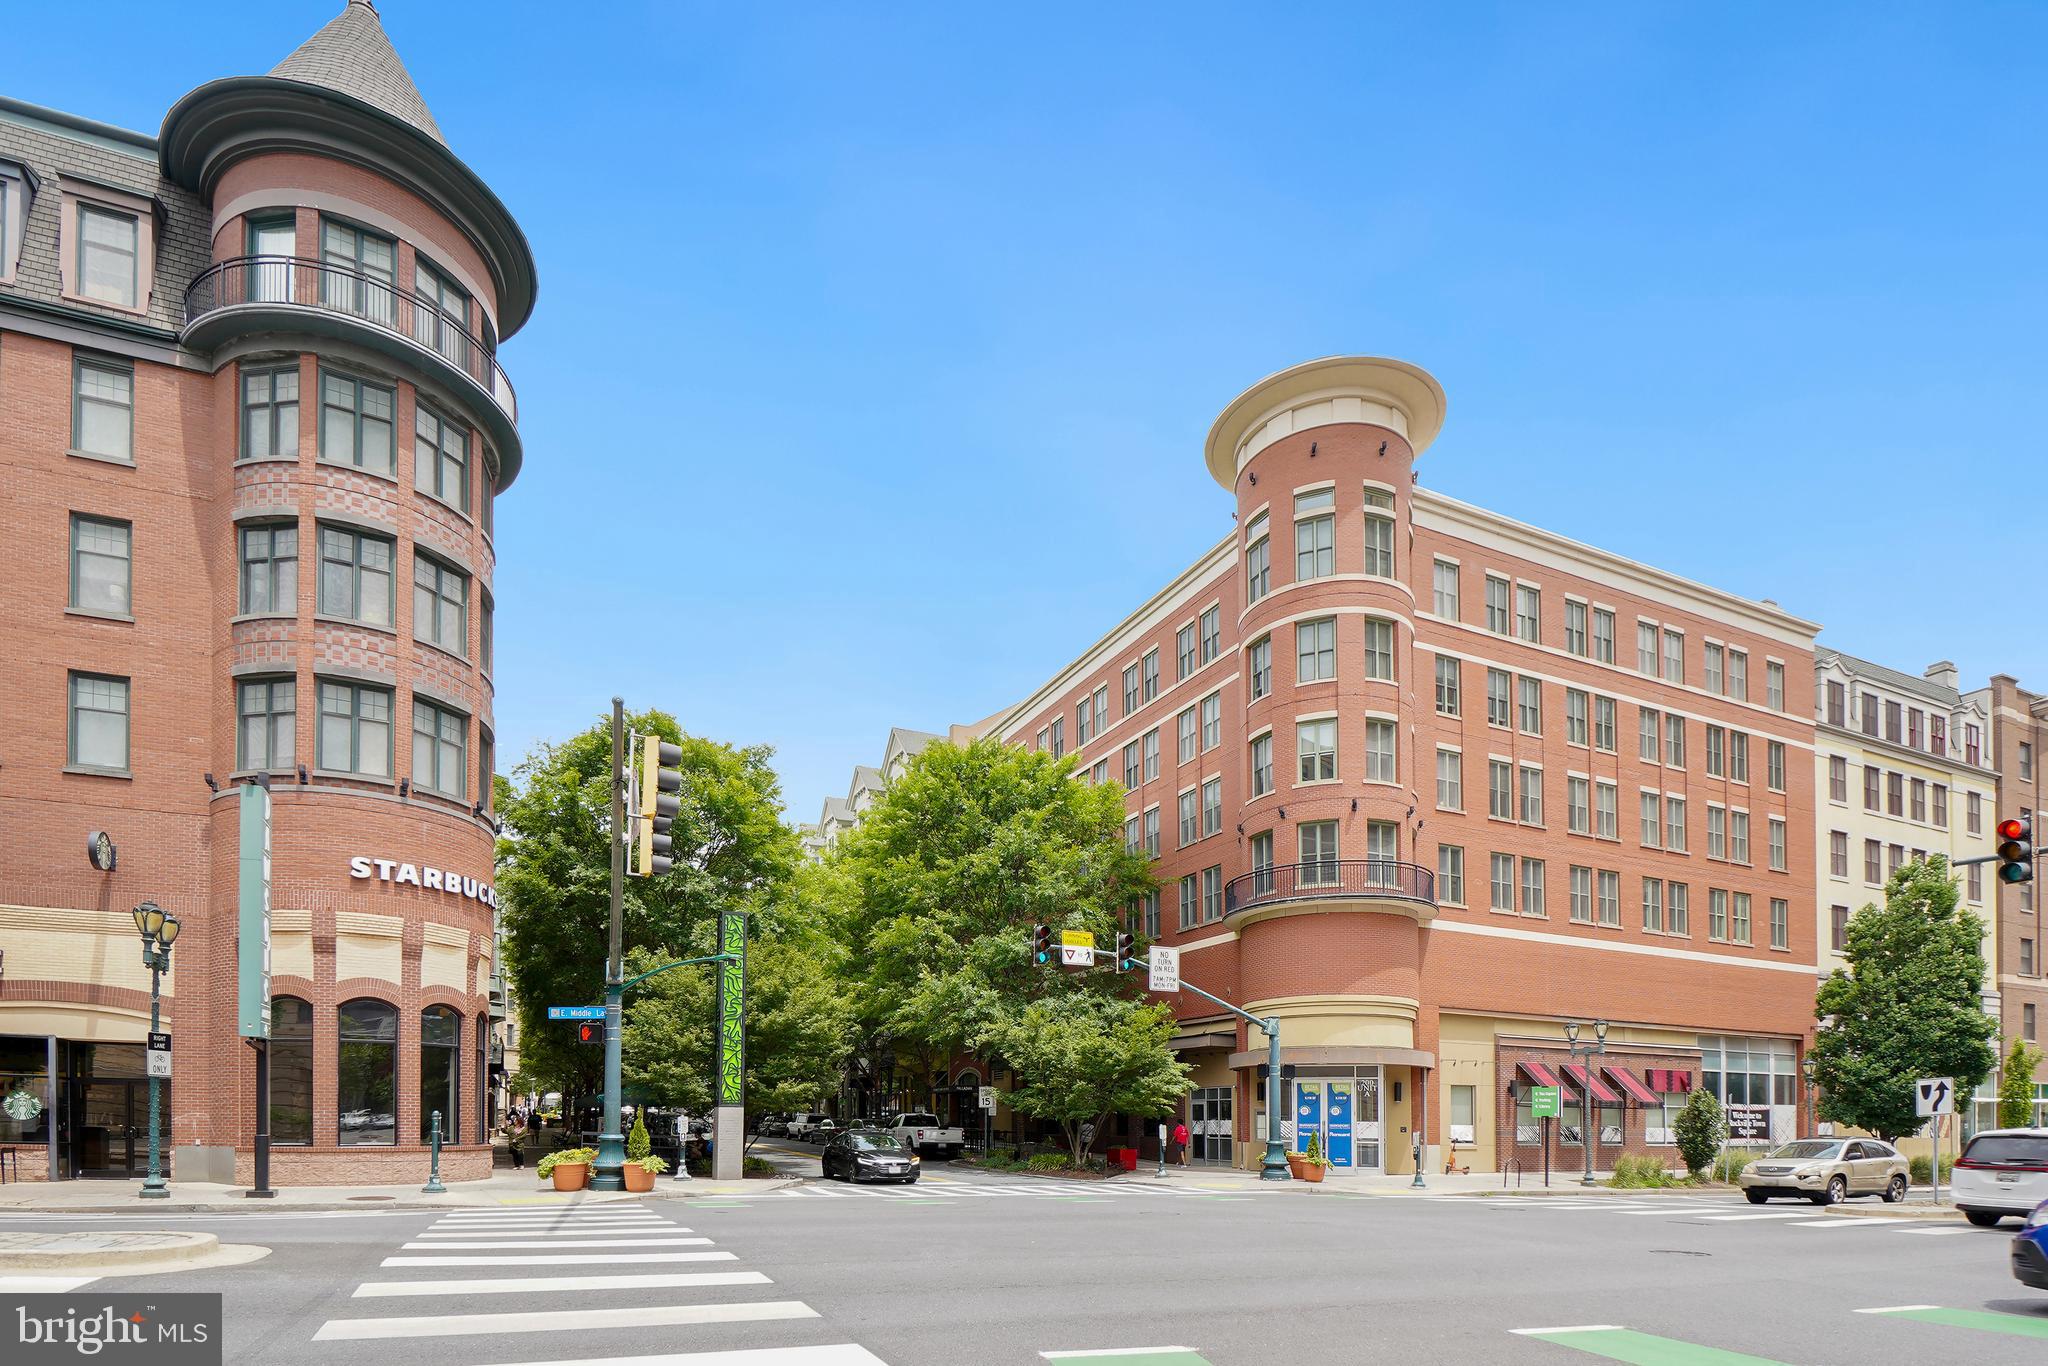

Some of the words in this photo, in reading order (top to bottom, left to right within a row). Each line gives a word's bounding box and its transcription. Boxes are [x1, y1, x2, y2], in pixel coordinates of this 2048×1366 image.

[1160, 951, 1169, 959] NO
[1157, 958, 1172, 966] TURN
[560, 1009, 568, 1017] E.
[570, 1009, 592, 1017] Middle
[153, 1034, 167, 1042] RIGHT
[152, 1065, 168, 1074] ONLY
[982, 1097, 991, 1106] 15
[1732, 1111, 1755, 1119] Welcome
[1729, 1119, 1752, 1127] Rockvile
[1752, 1119, 1766, 1127] Town
